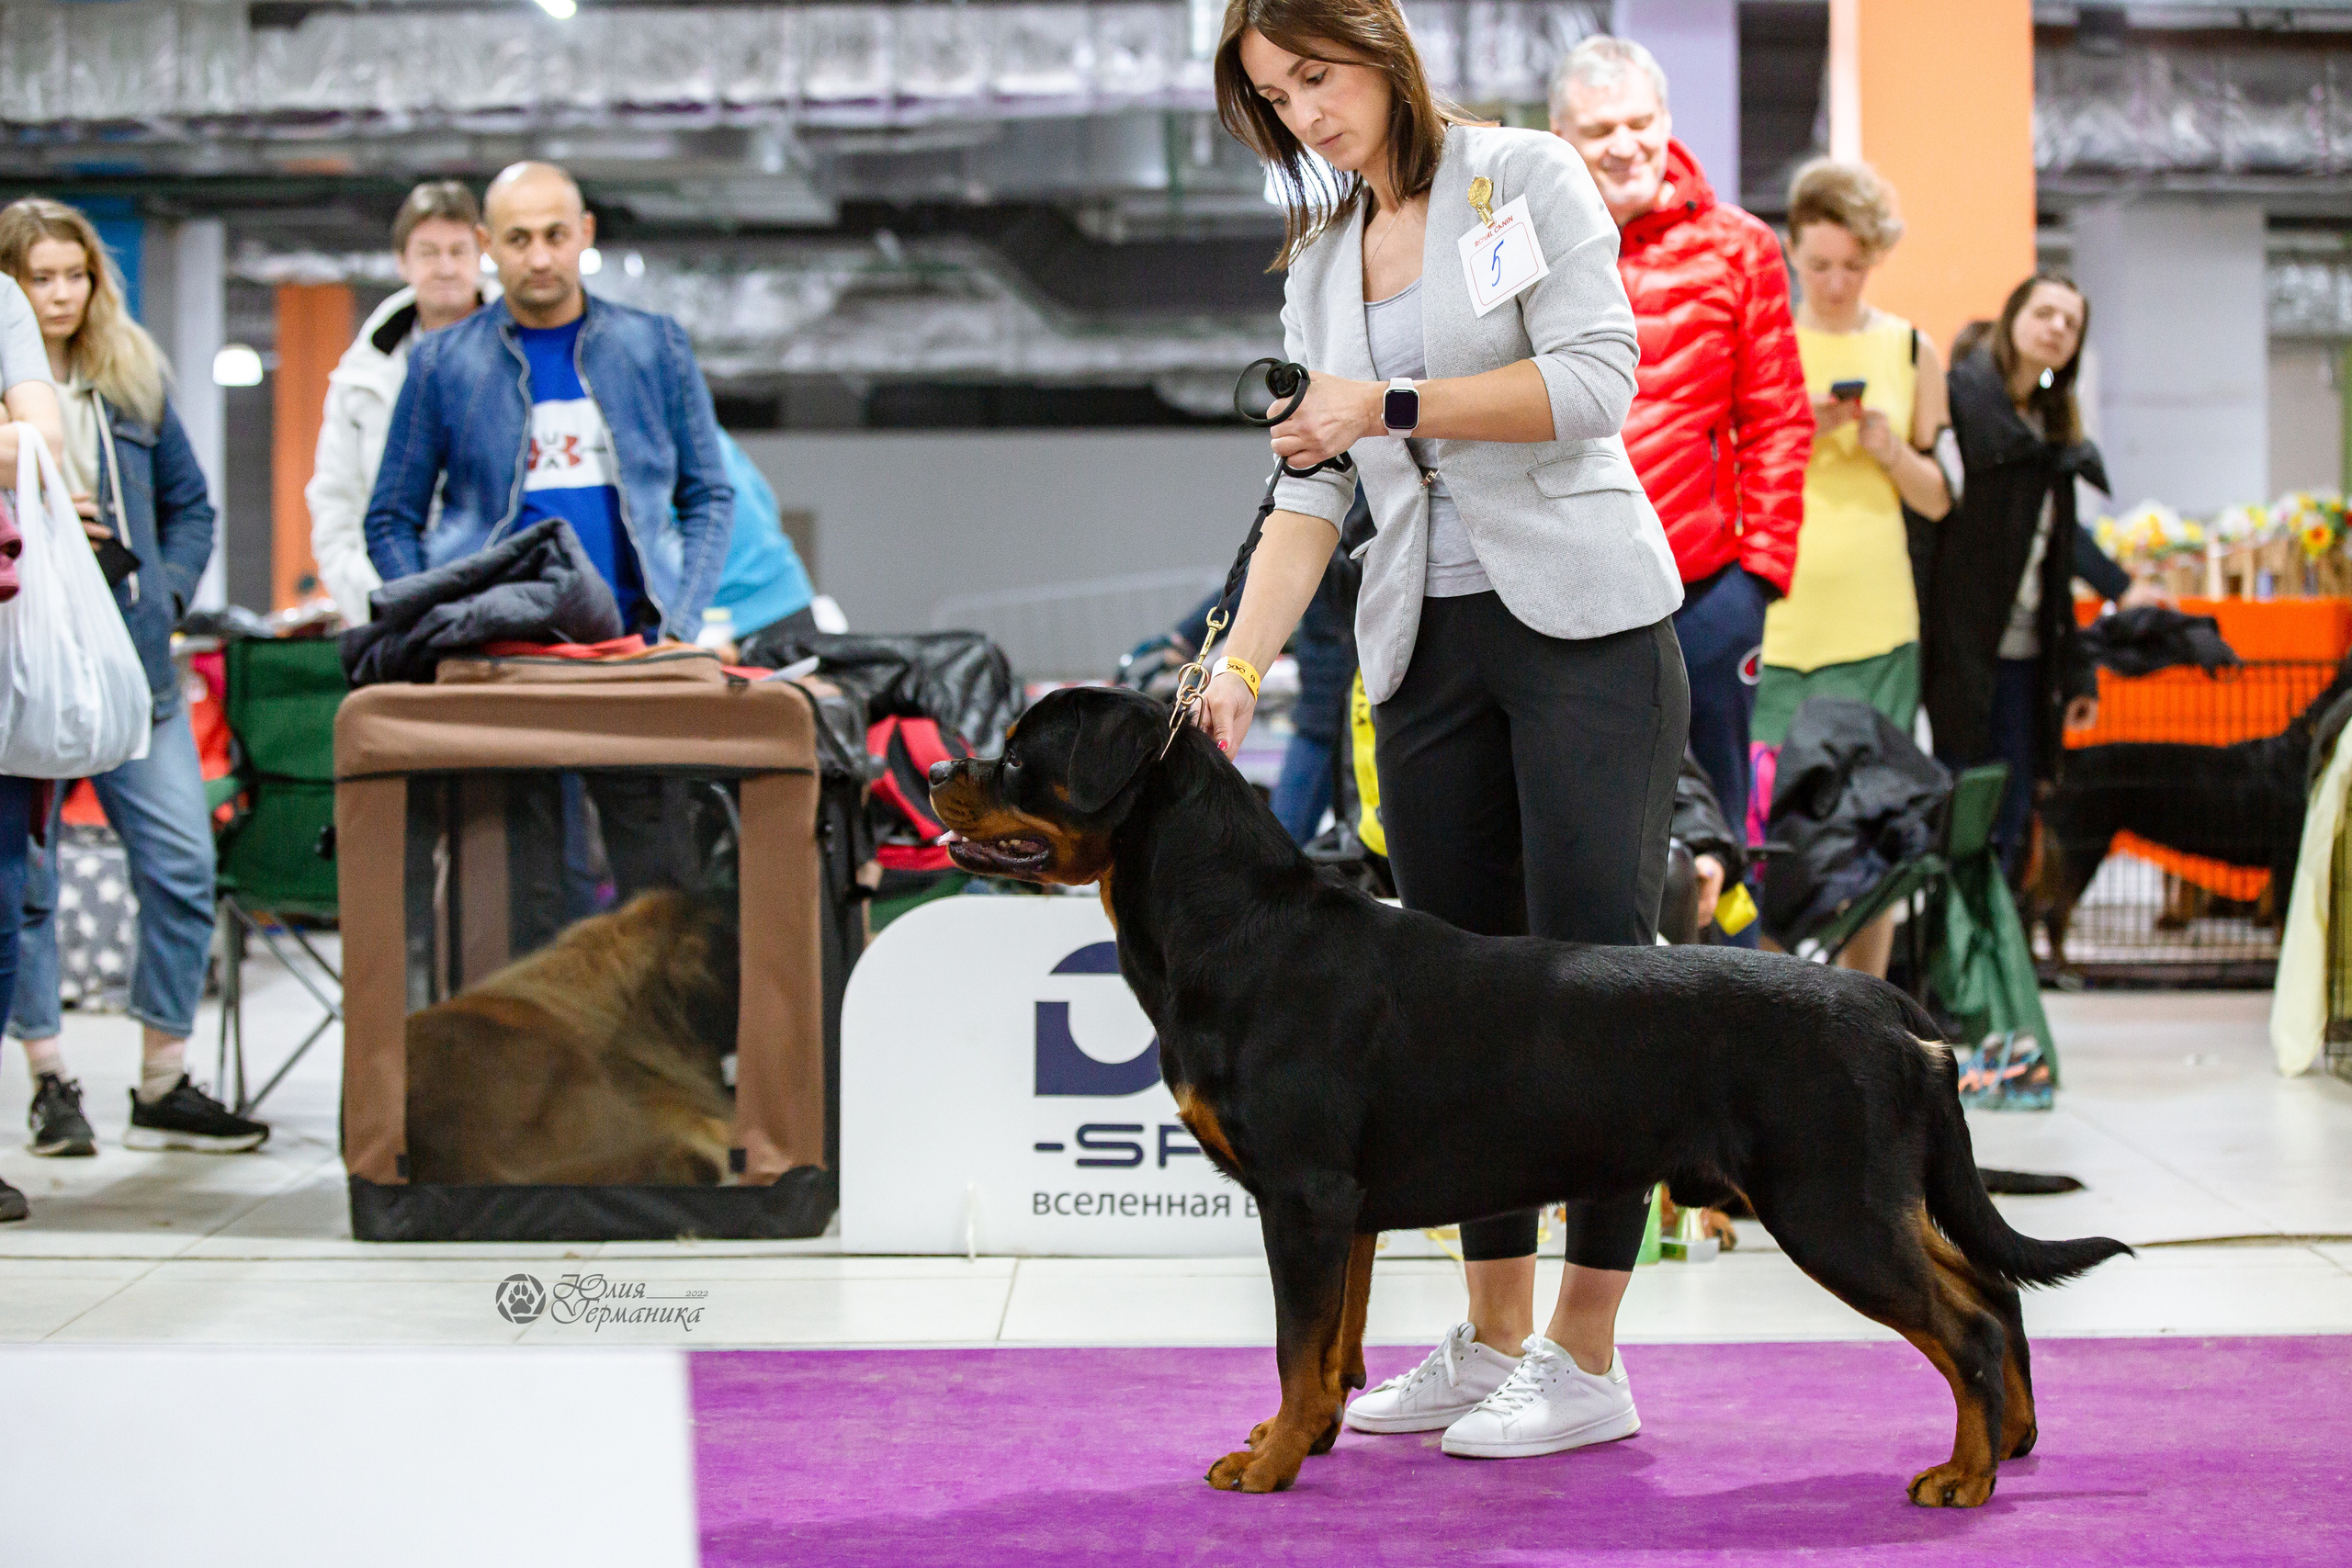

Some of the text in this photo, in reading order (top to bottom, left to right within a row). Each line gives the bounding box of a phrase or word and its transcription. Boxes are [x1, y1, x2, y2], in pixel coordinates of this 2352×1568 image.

[1475, 216, 1514, 247] ROYAL CANIN
[1491, 239, 1505, 287] 5
[1033, 1192, 1230, 1218] вселенная
